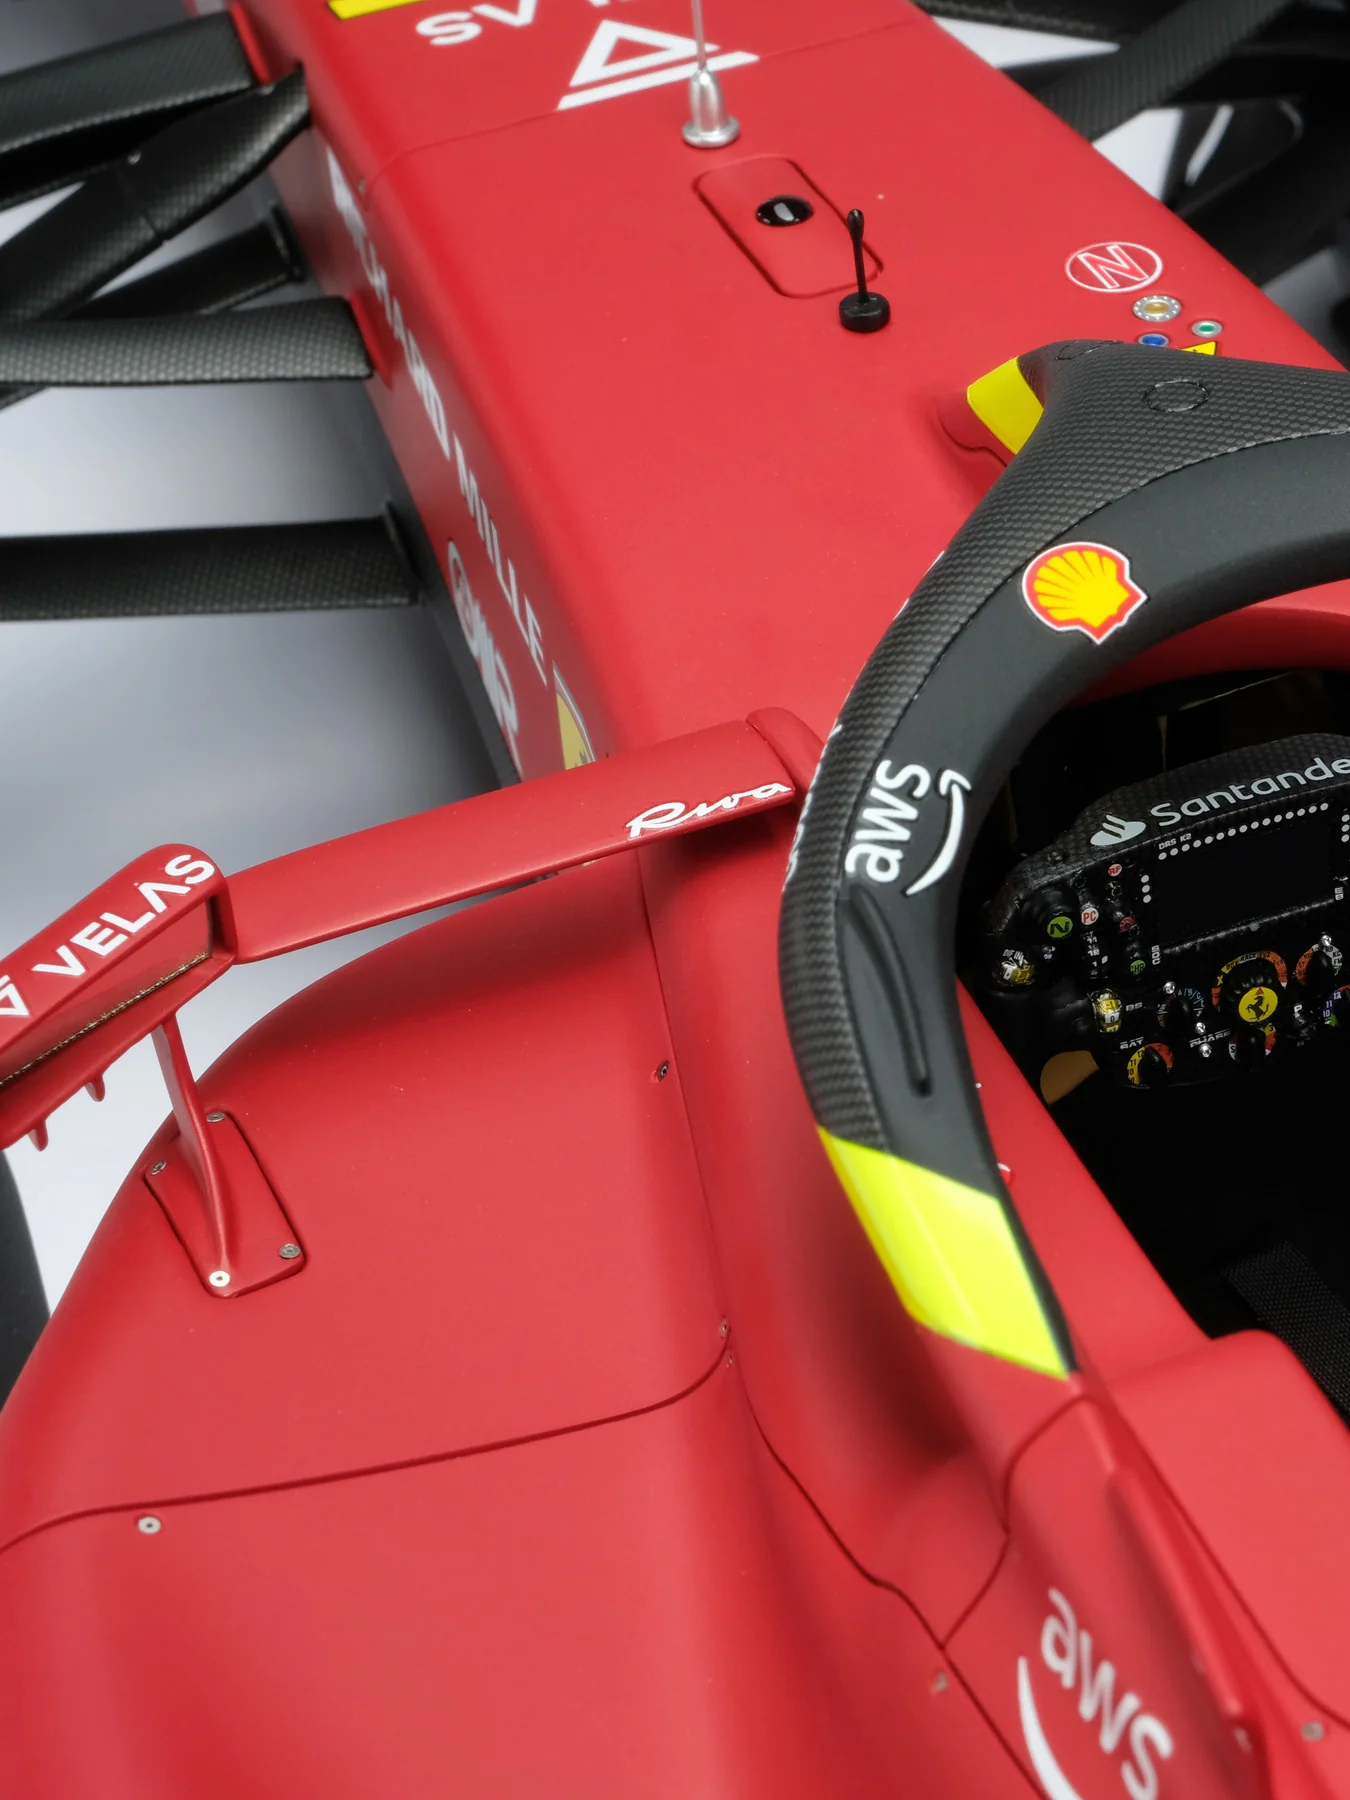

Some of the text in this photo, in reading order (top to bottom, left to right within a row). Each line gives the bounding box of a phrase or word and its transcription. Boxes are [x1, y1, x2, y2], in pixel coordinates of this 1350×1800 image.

[625, 782, 792, 838] Riva
[845, 759, 930, 883] aws
[1158, 833, 1192, 850] DRS K2
[1083, 910, 1097, 923] PC
[1041, 1587, 1174, 1800] aws
